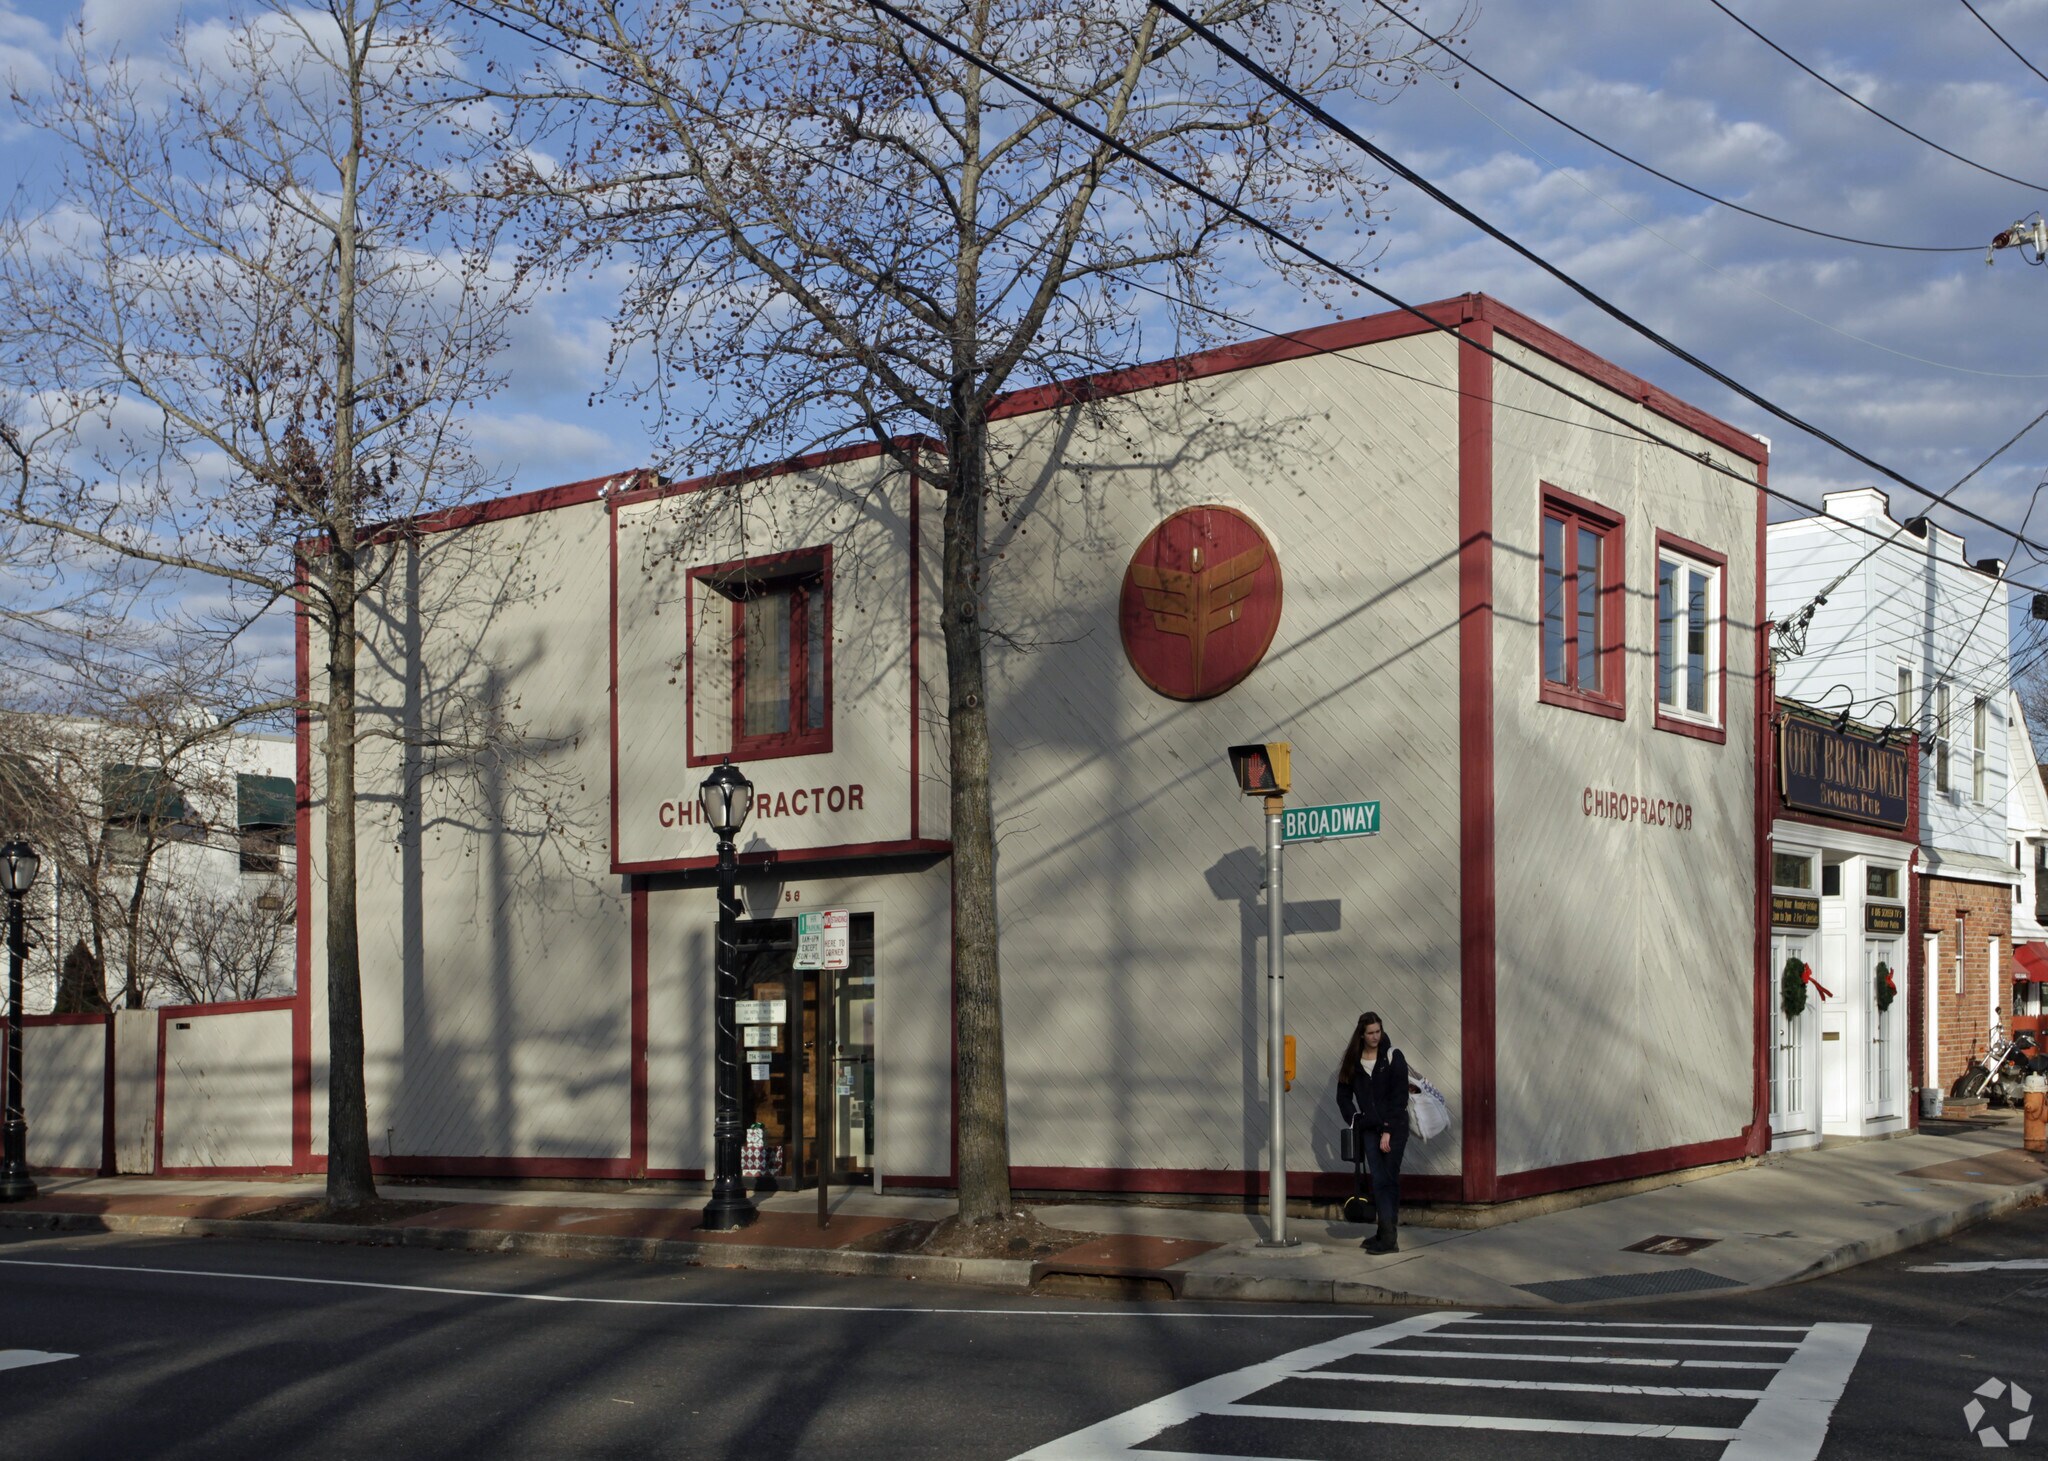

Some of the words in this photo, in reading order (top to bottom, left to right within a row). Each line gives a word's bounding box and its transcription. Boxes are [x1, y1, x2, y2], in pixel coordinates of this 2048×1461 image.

[1787, 724, 1820, 780] OFF
[1823, 734, 1906, 800] BROADWAY
[658, 783, 864, 828] CHIRACTOR
[1582, 786, 1692, 831] CHIROPRACTOR
[1286, 805, 1376, 837] BROADWAY
[785, 890, 800, 902] 58
[831, 916, 847, 924] STANDING
[806, 923, 821, 931] PARKING
[802, 943, 818, 952] EXCEPT
[825, 939, 837, 948] HERE
[839, 939, 845, 947] TO
[825, 948, 844, 957] CORNER
